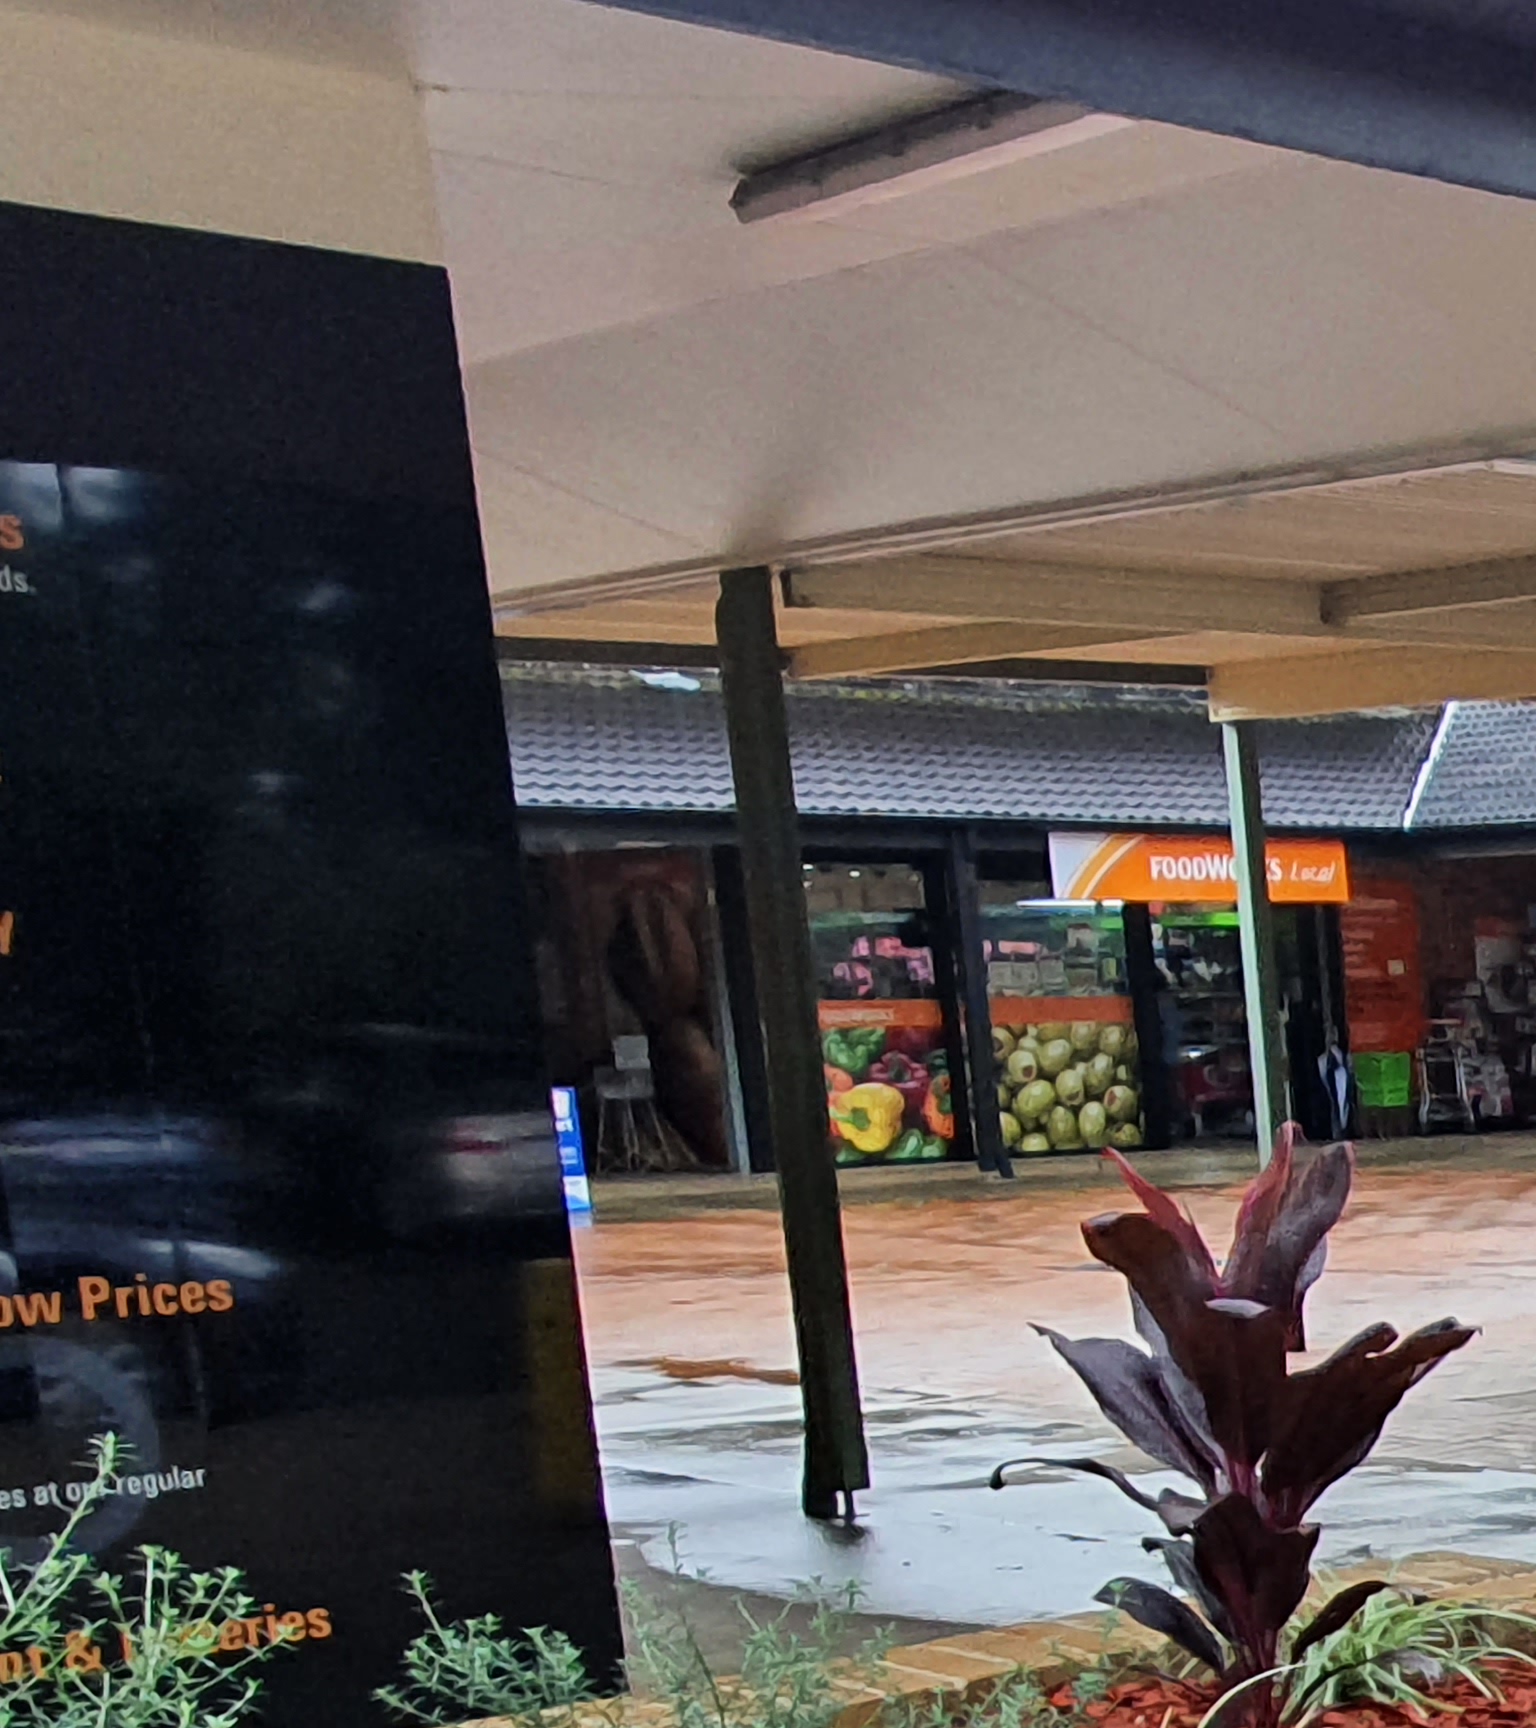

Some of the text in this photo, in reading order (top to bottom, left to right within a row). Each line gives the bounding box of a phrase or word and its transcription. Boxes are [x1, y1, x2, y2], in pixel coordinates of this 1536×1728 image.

[1290, 861, 1336, 883] Local
[78, 1272, 233, 1320] Prices
[116, 1465, 206, 1498] regular
[64, 1629, 106, 1674] &
